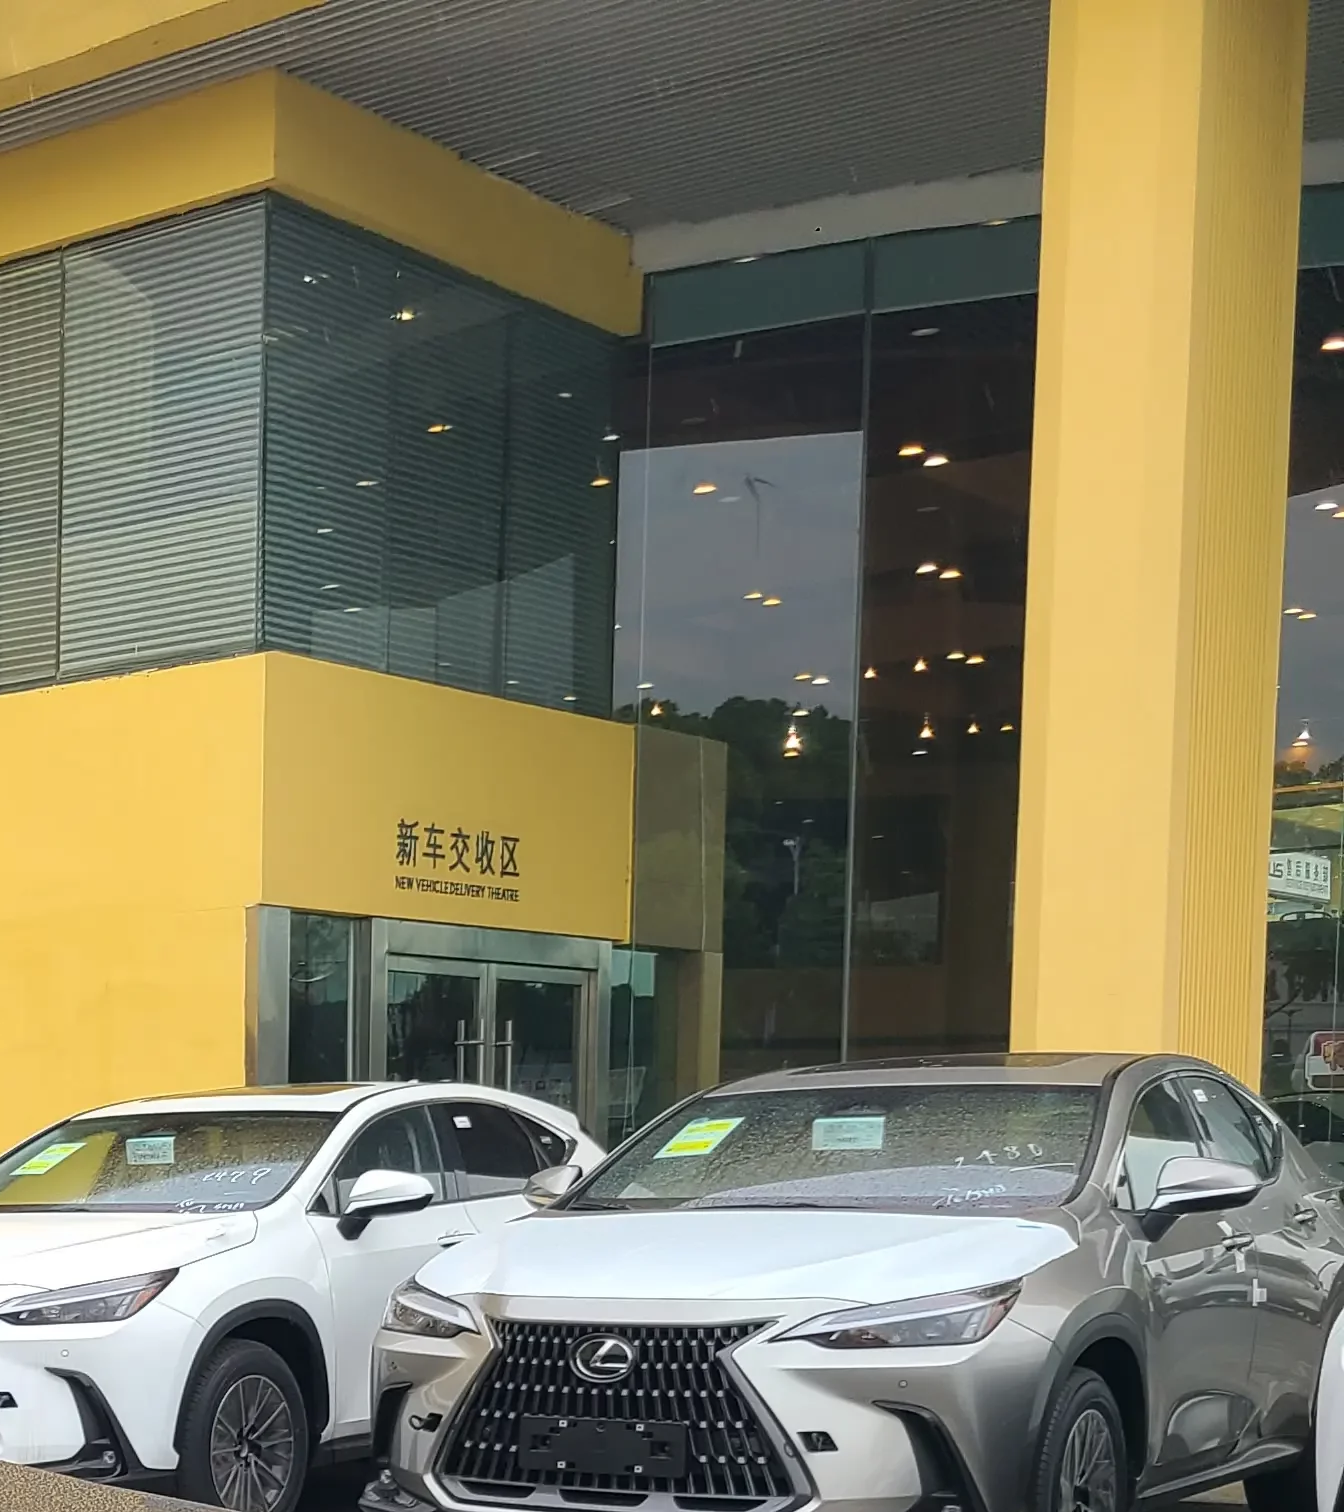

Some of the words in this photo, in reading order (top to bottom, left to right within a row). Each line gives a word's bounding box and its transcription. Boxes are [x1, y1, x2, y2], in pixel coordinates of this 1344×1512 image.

[395, 818, 520, 878] 新车交收区
[395, 875, 414, 890] NEW
[487, 886, 520, 902] THEATRE
